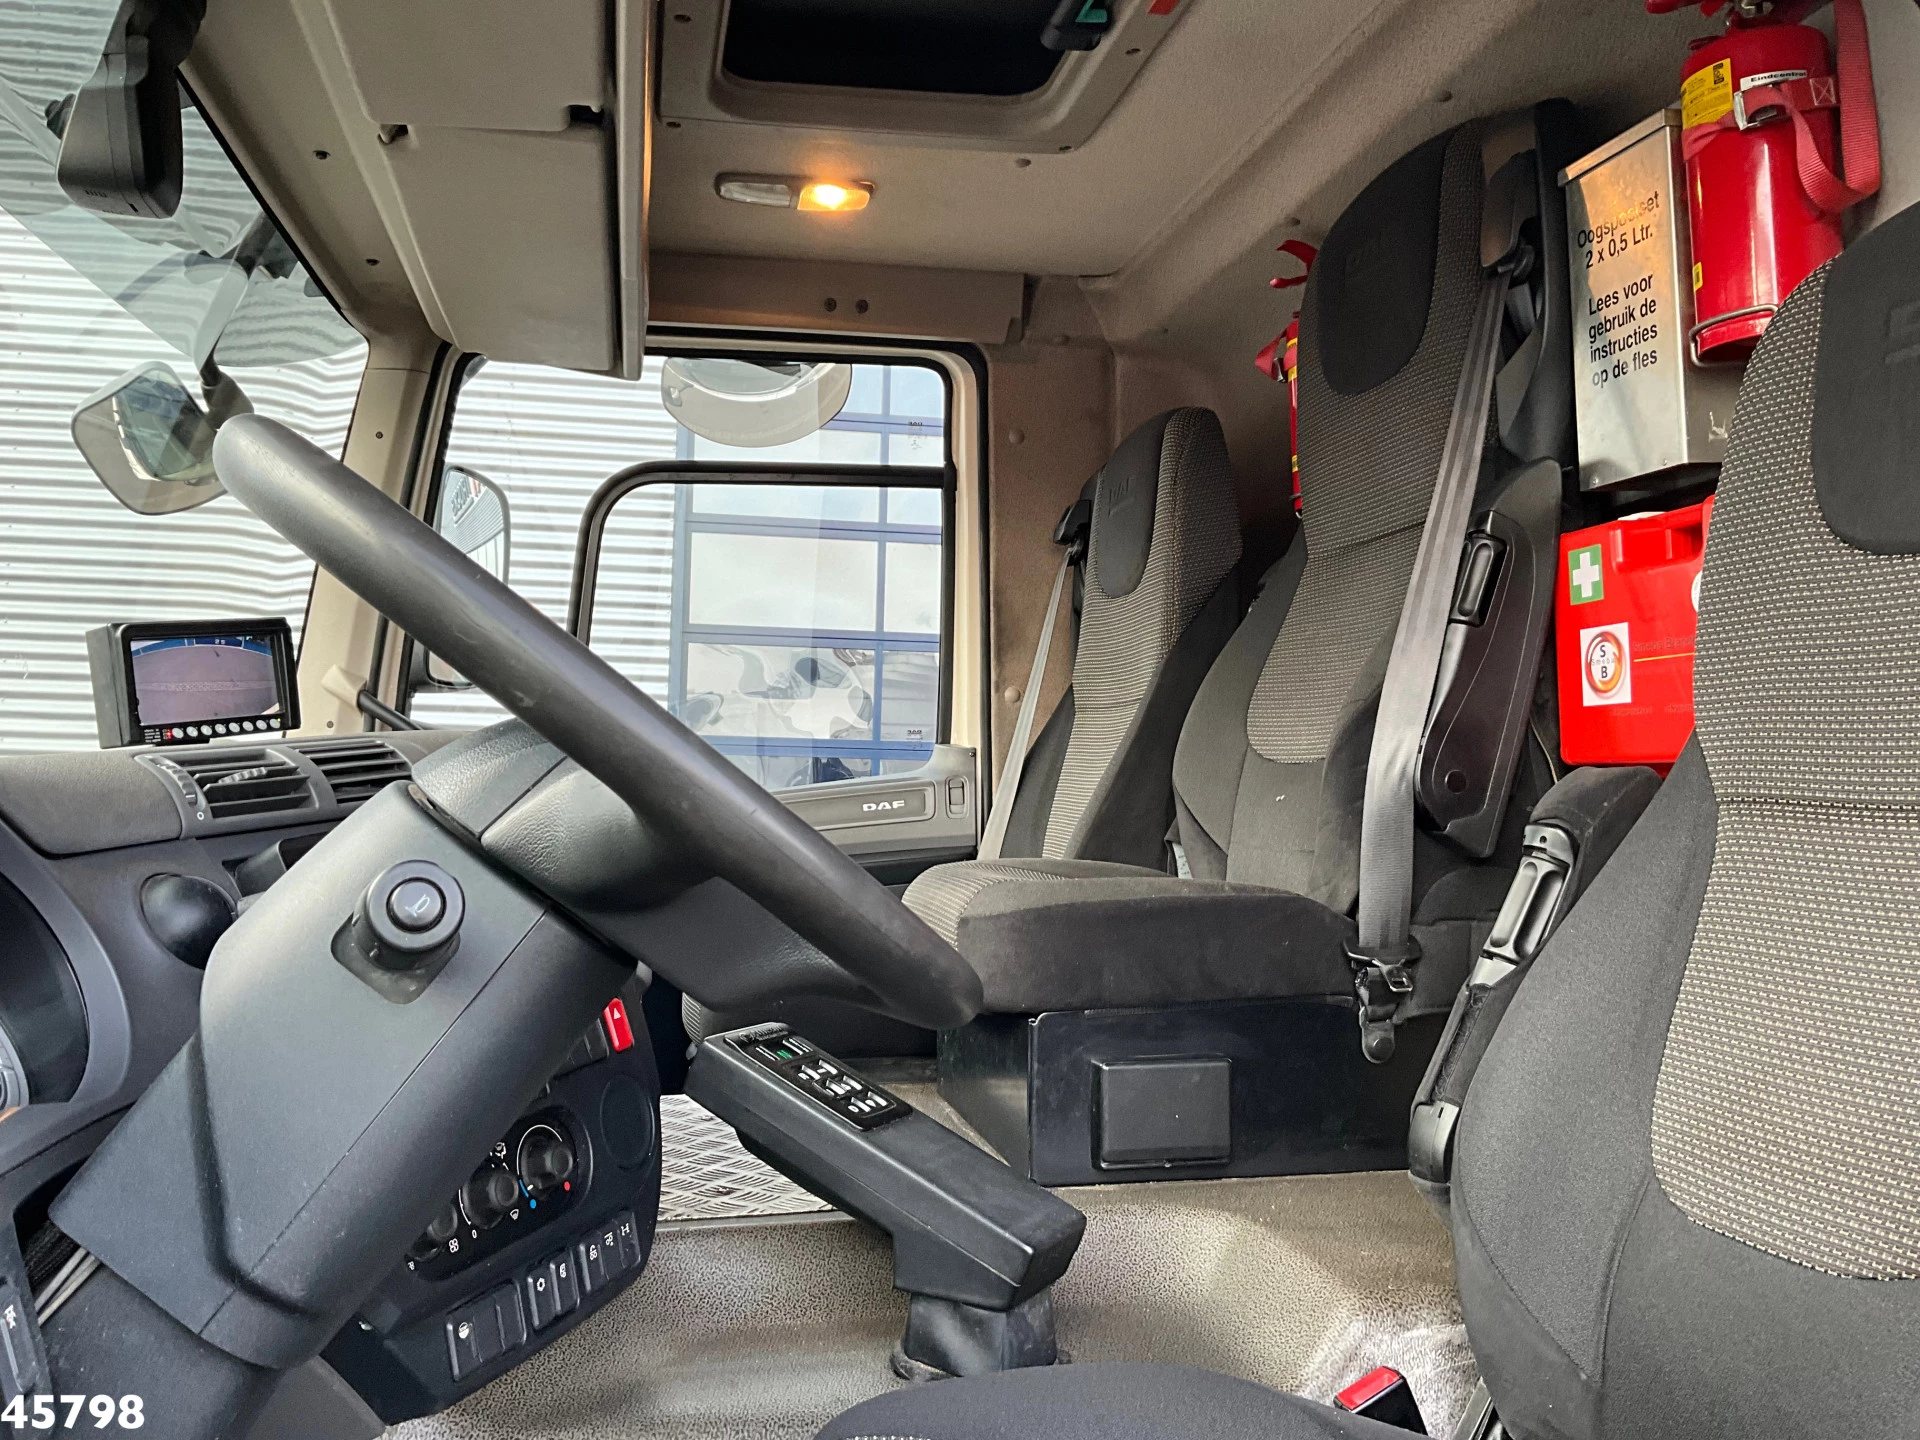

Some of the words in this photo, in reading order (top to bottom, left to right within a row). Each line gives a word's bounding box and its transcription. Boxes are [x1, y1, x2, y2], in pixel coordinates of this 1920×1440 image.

[1585, 250, 1594, 270] 2
[1597, 247, 1605, 264] x
[1608, 232, 1628, 258] 0,5
[1632, 223, 1654, 246] Ltr.
[1588, 292, 1619, 316] Lees
[1623, 273, 1654, 298] voor
[1588, 304, 1637, 345] gebruik
[1639, 297, 1657, 318] de
[1590, 323, 1658, 364] instructies
[1592, 368, 1608, 390] op
[1612, 357, 1629, 379] de
[1632, 349, 1658, 372] fles
[1600, 644, 1606, 657] S
[1601, 665, 1608, 679] B
[862, 800, 905, 812] DAF
